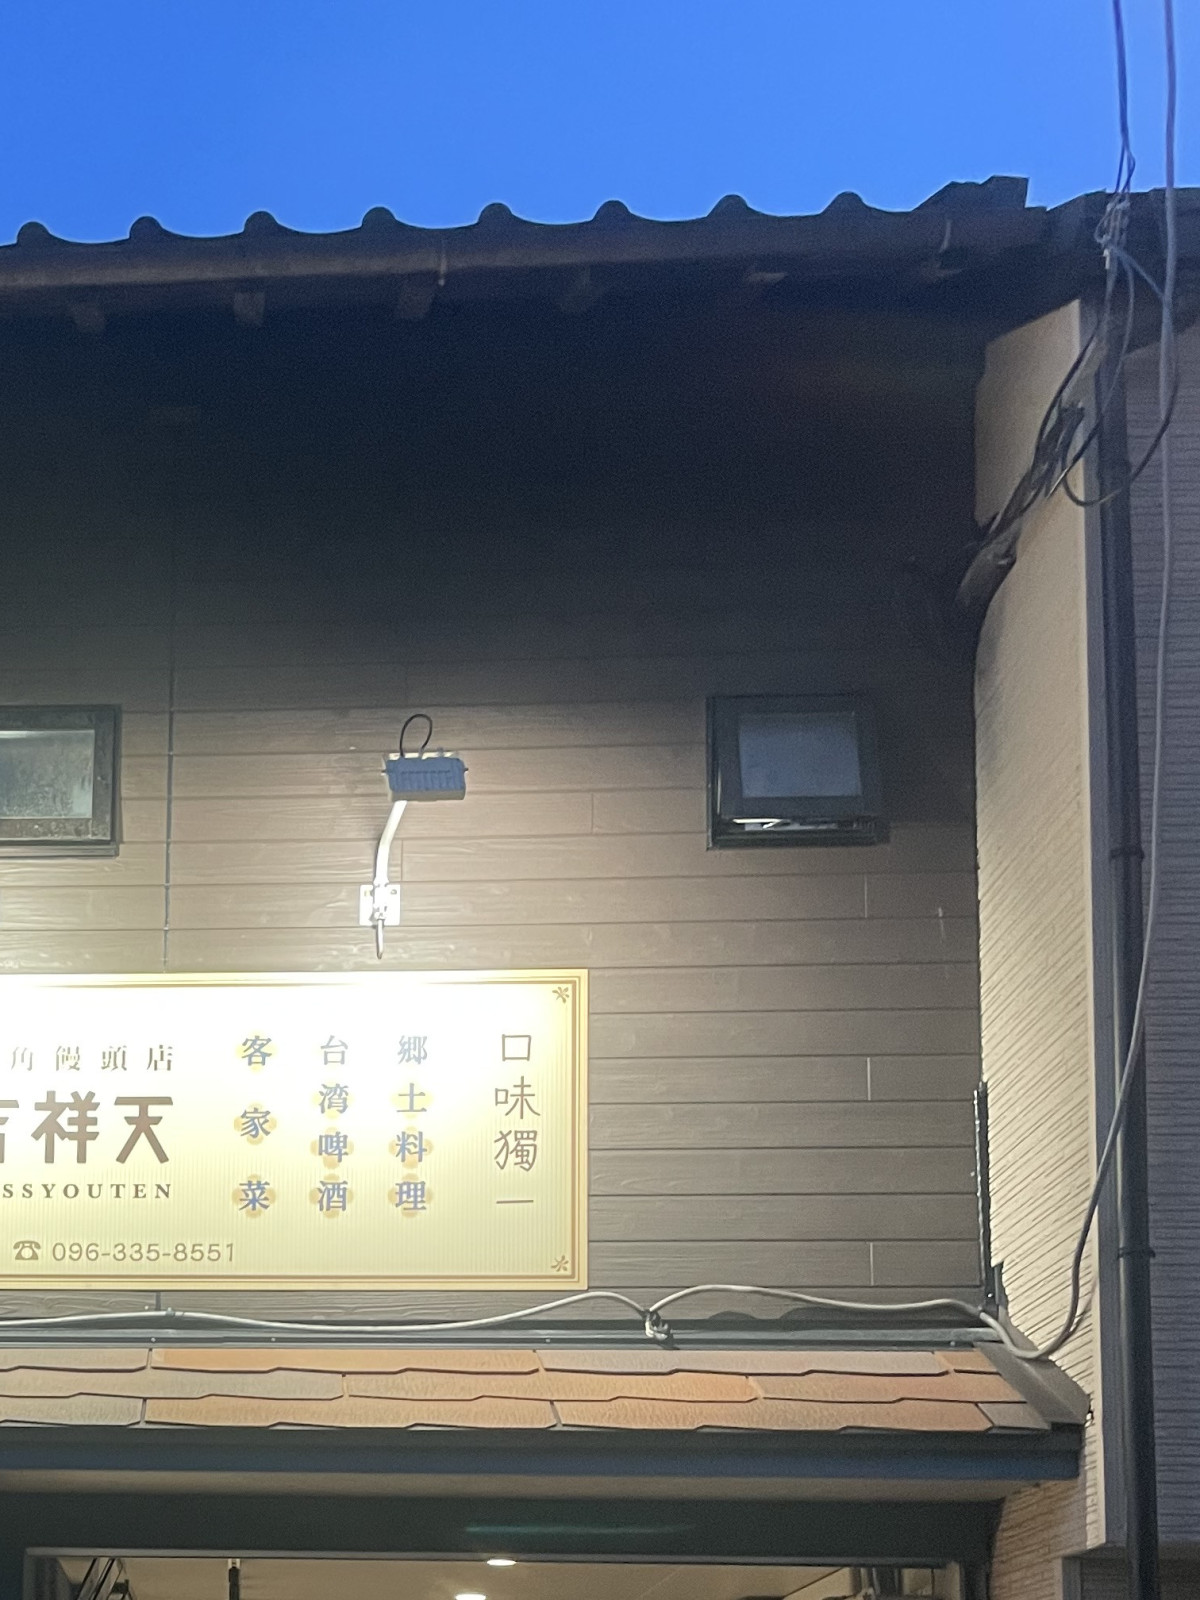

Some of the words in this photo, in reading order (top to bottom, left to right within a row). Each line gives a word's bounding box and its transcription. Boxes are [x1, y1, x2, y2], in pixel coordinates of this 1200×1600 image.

[238, 1034, 273, 1211] 客家菜
[316, 1034, 350, 1212] 台湾啤酒
[395, 1034, 429, 1211] 郷土料理
[493, 1033, 542, 1205] 口味獨一
[50, 1240, 236, 1263] 096-335-8551
